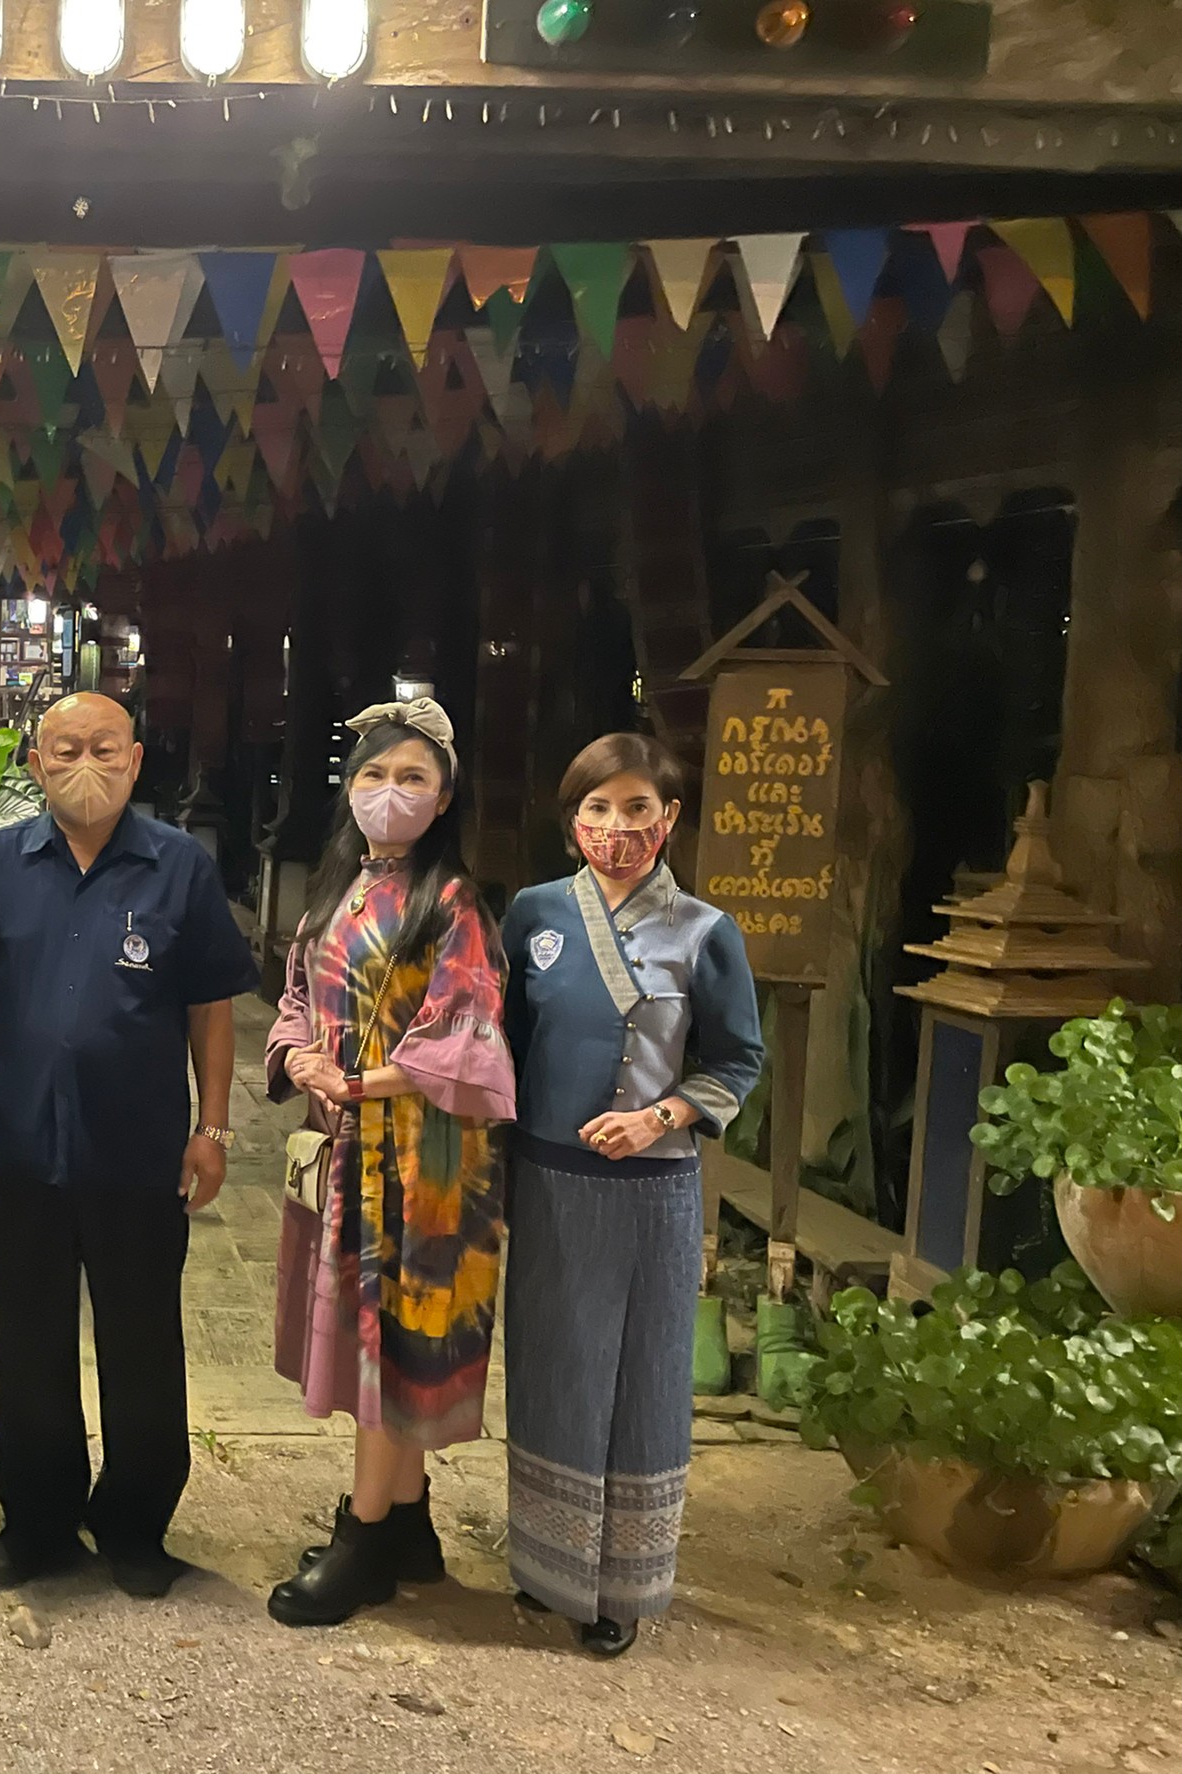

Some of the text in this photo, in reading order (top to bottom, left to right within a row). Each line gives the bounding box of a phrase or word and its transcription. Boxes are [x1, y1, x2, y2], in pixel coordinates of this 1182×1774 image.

[722, 716, 829, 750] กรุณา
[748, 781, 802, 803] และ
[714, 801, 824, 838] ชำระเงิน
[750, 834, 780, 866] ที่
[708, 864, 833, 900] เคาน์เตอร์
[735, 911, 803, 935] นะคะ
